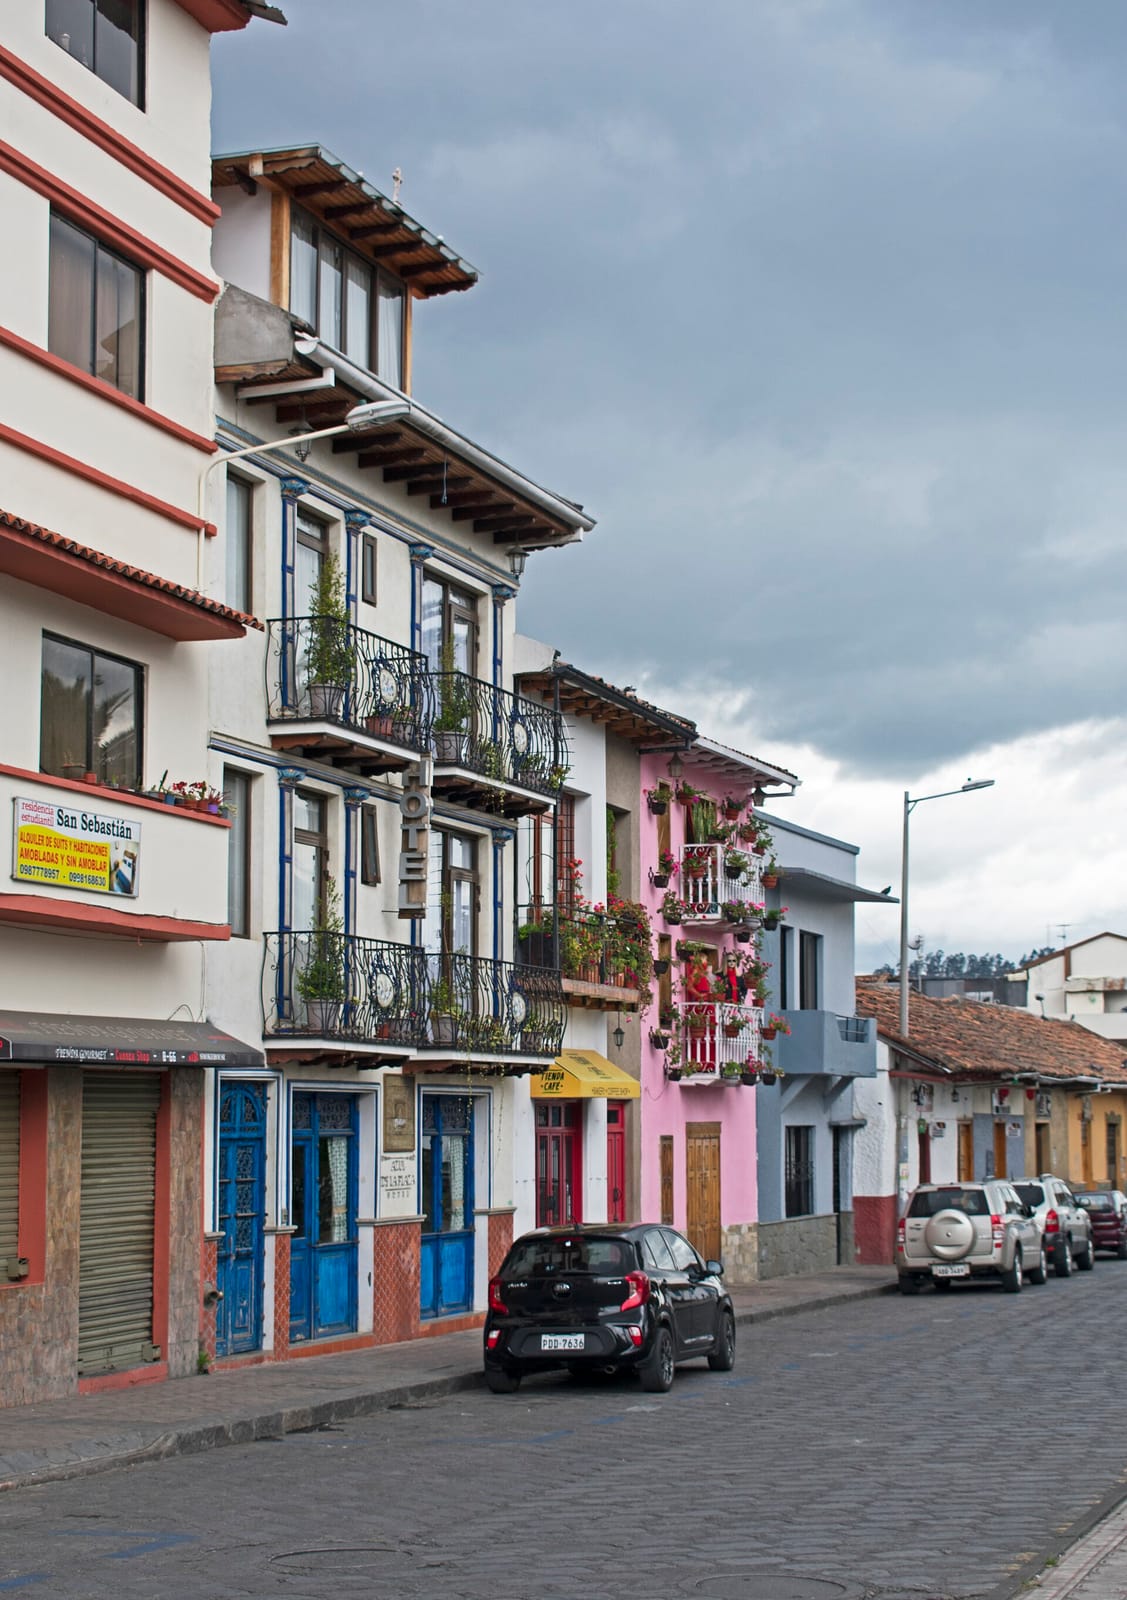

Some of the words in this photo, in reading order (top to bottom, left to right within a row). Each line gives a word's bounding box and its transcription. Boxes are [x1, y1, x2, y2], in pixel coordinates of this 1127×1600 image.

[22, 801, 54, 815] residencia
[57, 808, 78, 829] San
[81, 813, 132, 840] Sebastián
[399, 760, 433, 909] HOTEL
[20, 831, 45, 846] ALQUILER
[46, 836, 53, 848] DE
[54, 838, 69, 850] SUITS
[69, 840, 73, 851] Y
[74, 841, 108, 858] HABITACIONES
[20, 847, 59, 865] AMOBLADAS
[60, 854, 65, 865] Y
[66, 855, 77, 868] SIN
[79, 857, 108, 872] AMOBLAR
[541, 1071, 565, 1081] TIENDA
[542, 1338, 584, 1349] PDD-7636
